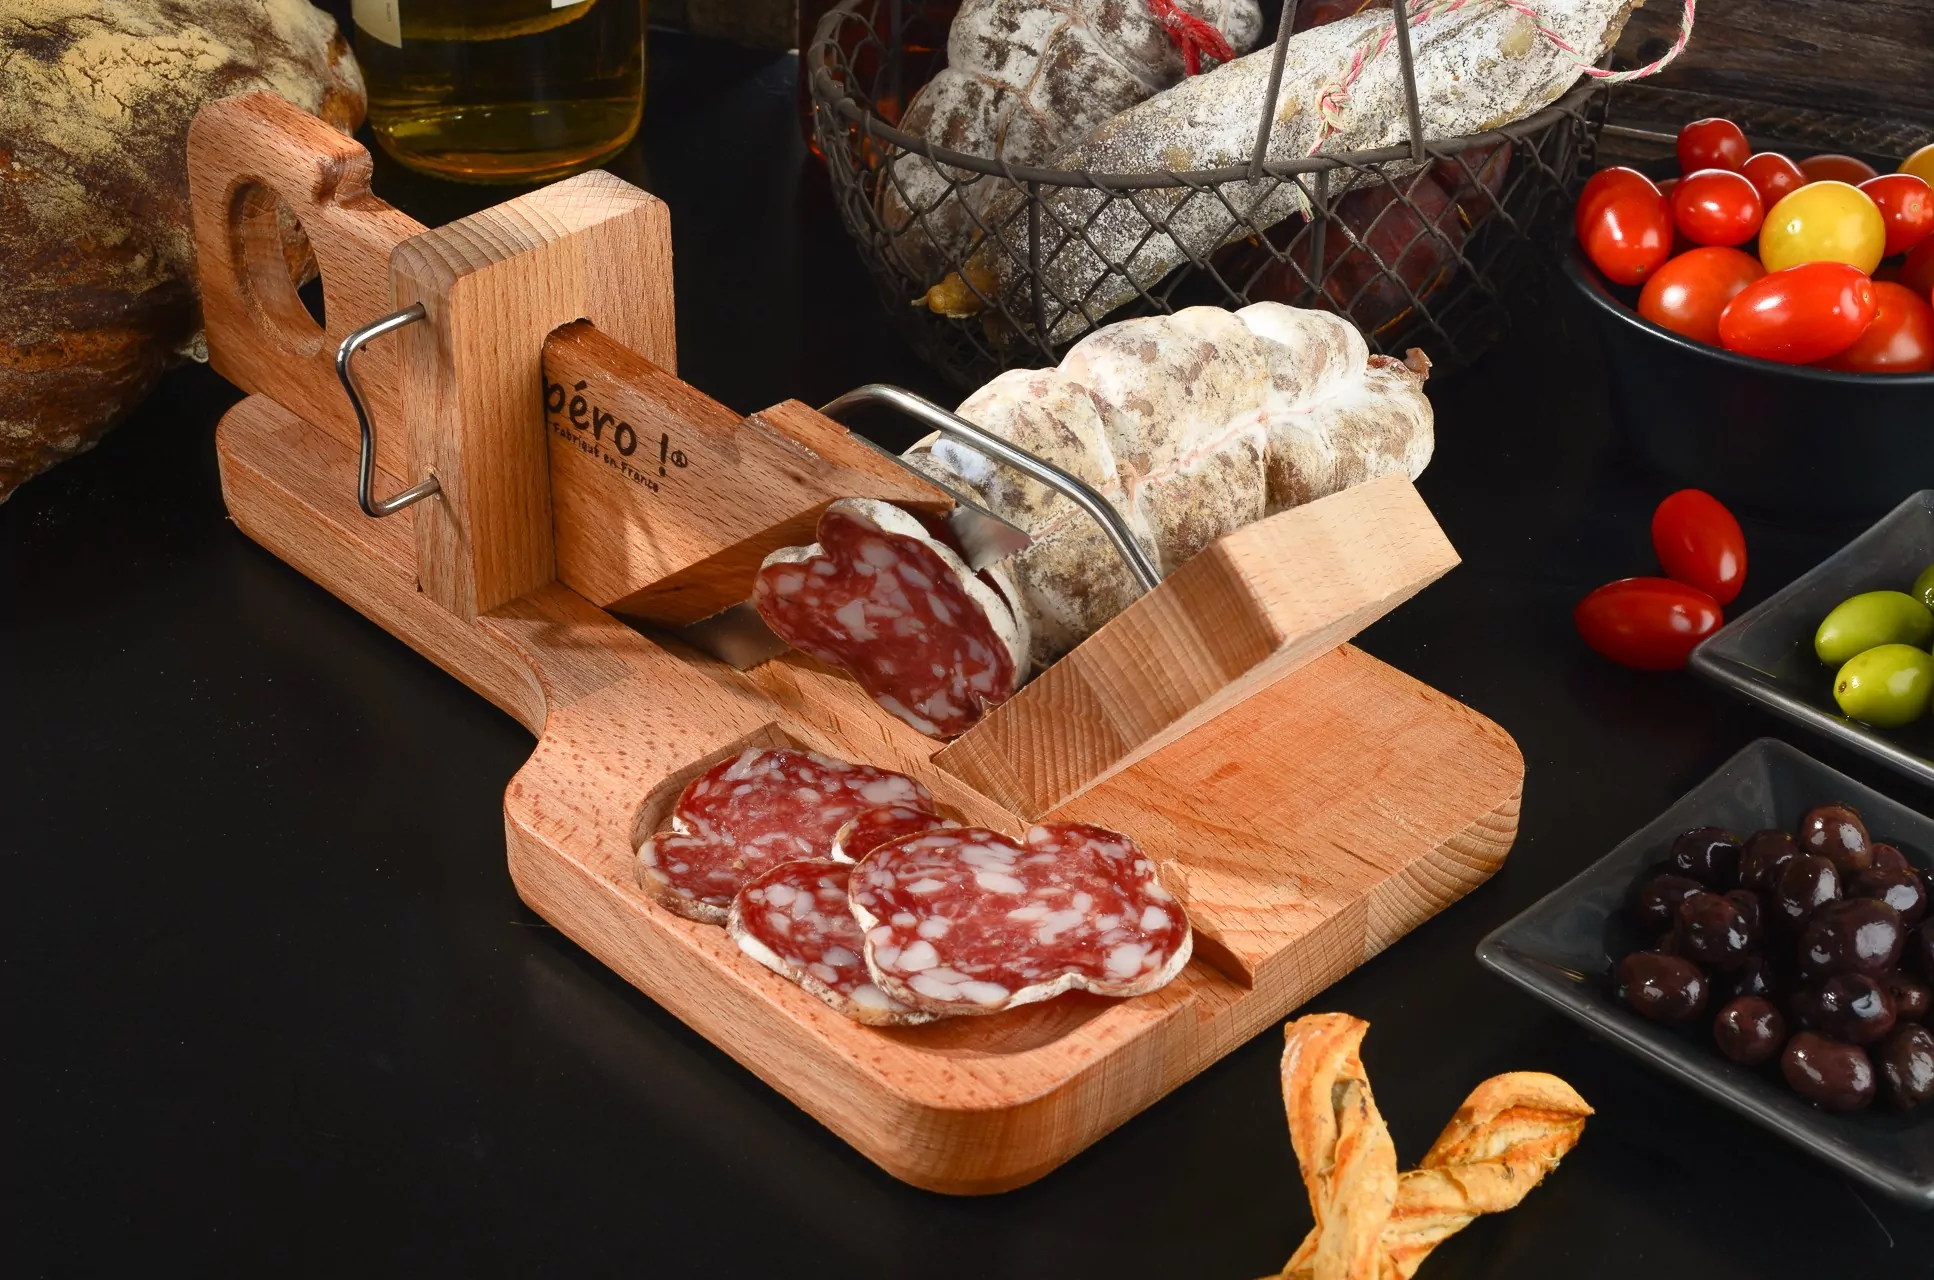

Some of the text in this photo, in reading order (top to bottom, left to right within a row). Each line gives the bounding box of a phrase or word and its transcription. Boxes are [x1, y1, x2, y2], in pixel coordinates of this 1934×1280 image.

[553, 423, 659, 493] Fabriqué en France
